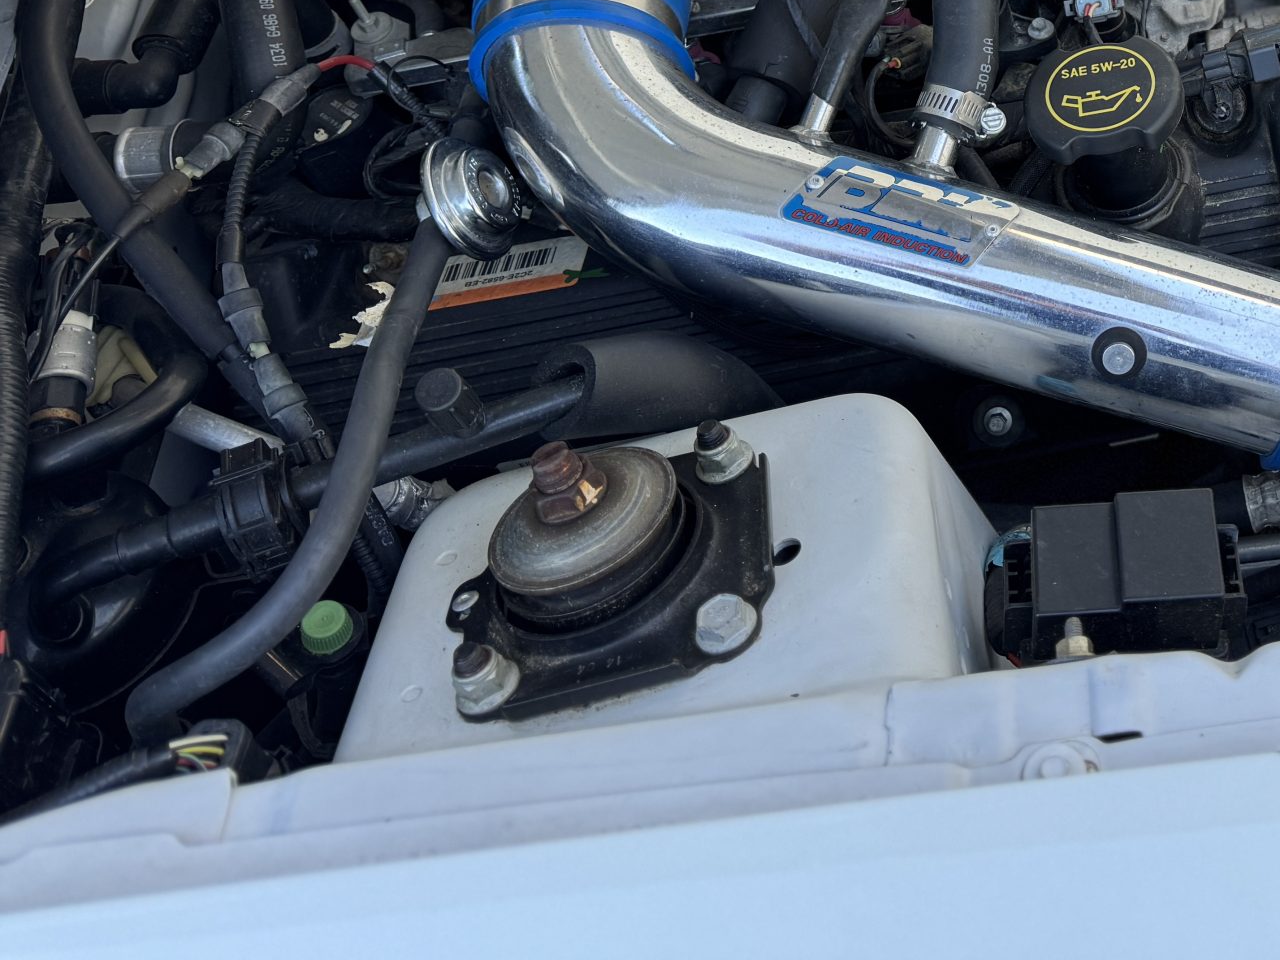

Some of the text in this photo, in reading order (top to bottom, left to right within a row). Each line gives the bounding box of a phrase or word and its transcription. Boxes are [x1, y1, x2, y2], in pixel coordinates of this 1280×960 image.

[263, 13, 281, 38] 6486
[269, 42, 288, 68] 1034
[1061, 57, 1136, 79] SAE 5W-20
[791, 208, 970, 264] COLD-AIR INDUCTION
